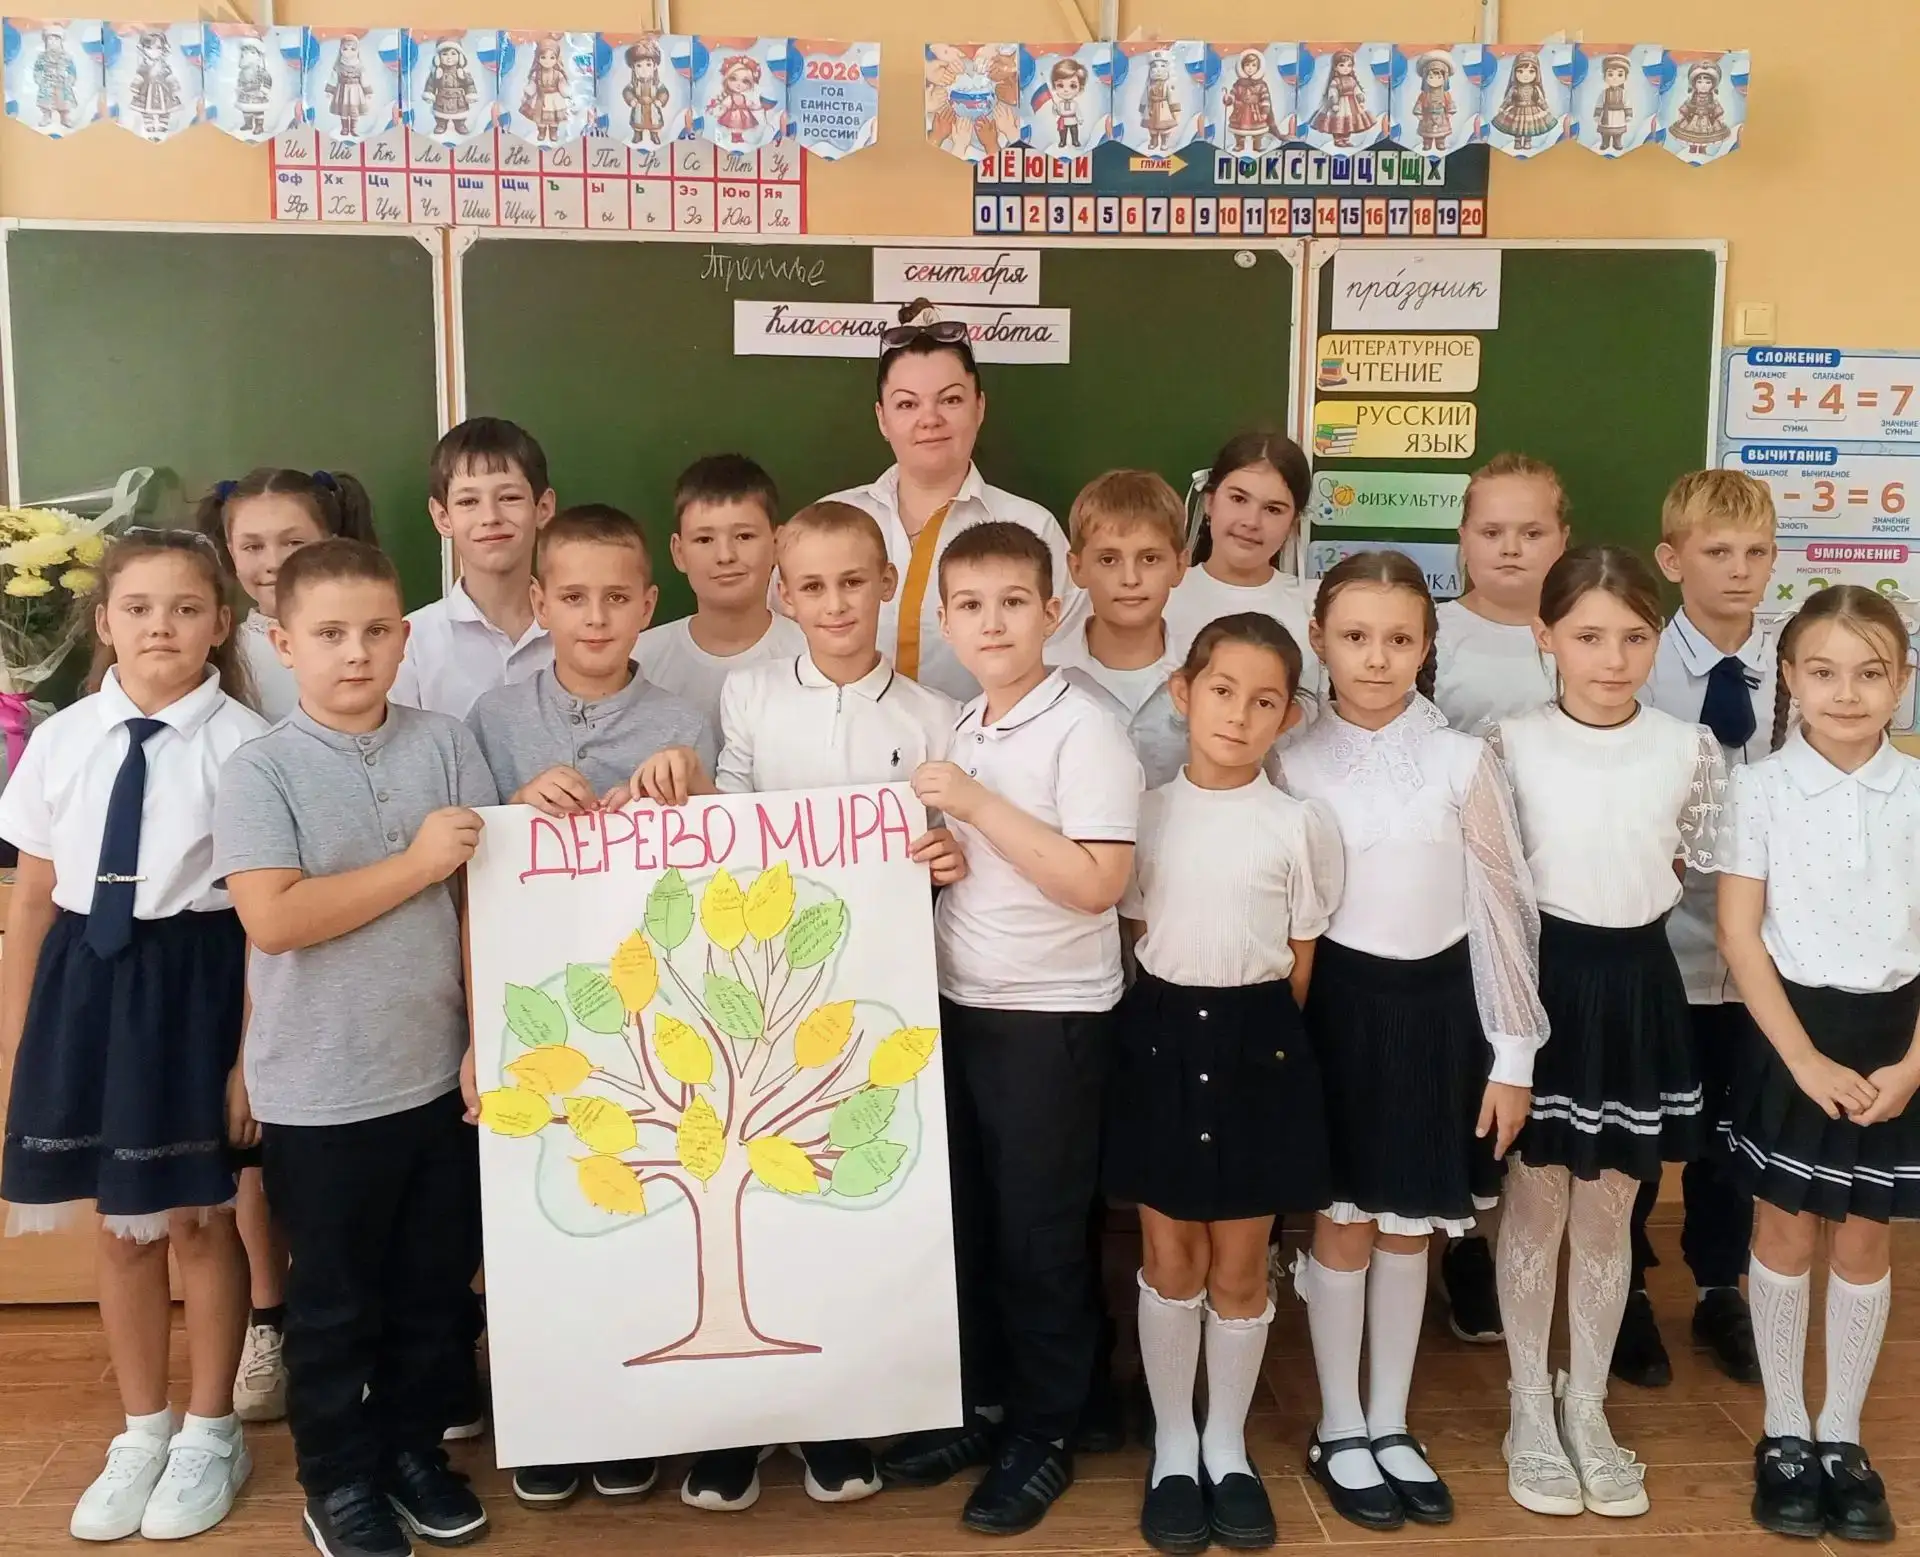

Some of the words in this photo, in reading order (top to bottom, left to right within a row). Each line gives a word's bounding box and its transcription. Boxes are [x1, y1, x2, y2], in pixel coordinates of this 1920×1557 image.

[806, 61, 860, 81] 2026
[820, 86, 844, 97] ГОД
[800, 100, 863, 112] ЕДИНСТВА
[802, 113, 860, 126] НАРОДОВ
[803, 127, 858, 140] РОССИИ!
[981, 155, 995, 177] Я
[1004, 151, 1015, 177] Ё
[1025, 157, 1044, 177] Ю
[1075, 157, 1088, 178] И
[1140, 160, 1172, 169] ГЛУХИЕ
[1332, 157, 1350, 180] Ш
[278, 173, 302, 186] Фф
[324, 173, 343, 184] Хх
[368, 174, 390, 187] Цц
[413, 176, 433, 187] Чч
[458, 178, 484, 189] Шш
[502, 178, 530, 192] Щщ
[679, 185, 698, 196] Ээ
[722, 187, 750, 198] Юю
[764, 188, 782, 199] Яя
[981, 206, 991, 224] 0
[1006, 206, 1014, 224] 1
[1029, 206, 1040, 224] 2
[1054, 206, 1064, 224] 3
[1078, 206, 1088, 224] 4
[1103, 206, 1112, 224] 5
[1127, 206, 1136, 224] 6
[1151, 206, 1162, 224] 7
[1175, 206, 1185, 224] 8
[1200, 206, 1210, 224] 9
[1220, 207, 1237, 225] 10
[1246, 207, 1262, 225] 11
[1269, 207, 1287, 225] 12
[1293, 207, 1311, 225] 13
[1318, 207, 1336, 225] 14
[1341, 207, 1360, 225] 15
[1366, 207, 1383, 225] 16
[1390, 207, 1408, 225] 17
[1414, 207, 1431, 225] 18
[1438, 207, 1457, 225] 19
[1461, 207, 1482, 225] 20
[904, 253, 1028, 295] сентября
[765, 305, 887, 338] Классная
[967, 312, 1053, 342] абота
[1326, 340, 1474, 356] ЛИТЕРАТУРНОЕ
[1755, 351, 1832, 364] СЛОЖЕНИЕ
[1346, 362, 1442, 382] ЧТЕНИЕ
[1744, 371, 1787, 379] СЛАГАЕМОЕ
[1812, 372, 1855, 381] СЛАГАЕМОЕ
[1752, 381, 1775, 414] 3
[1818, 384, 1845, 414] 4
[1890, 385, 1914, 416] 7
[1356, 404, 1471, 426] РУССКИЙ
[1782, 425, 1808, 433] СУММА
[1885, 428, 1912, 436] СУММЫ
[1405, 434, 1468, 453] ЯЗЫК
[1748, 449, 1832, 462] ВЫЧИТАНИЕ
[1744, 469, 1788, 477] НЬШАЕМОЕ
[1801, 470, 1850, 478] ВЫЧИТАЕМОЕ
[1812, 481, 1835, 512] 3
[1881, 482, 1905, 513] 6
[1873, 517, 1910, 525] ЗНАЧЕНИЕ
[1814, 548, 1900, 560] УМНОЖЕНИЕ
[1796, 567, 1842, 575] МНОЖИТЕЛЬ
[519, 804, 736, 884] ДЕРЕВО
[755, 787, 913, 868] МИРА
